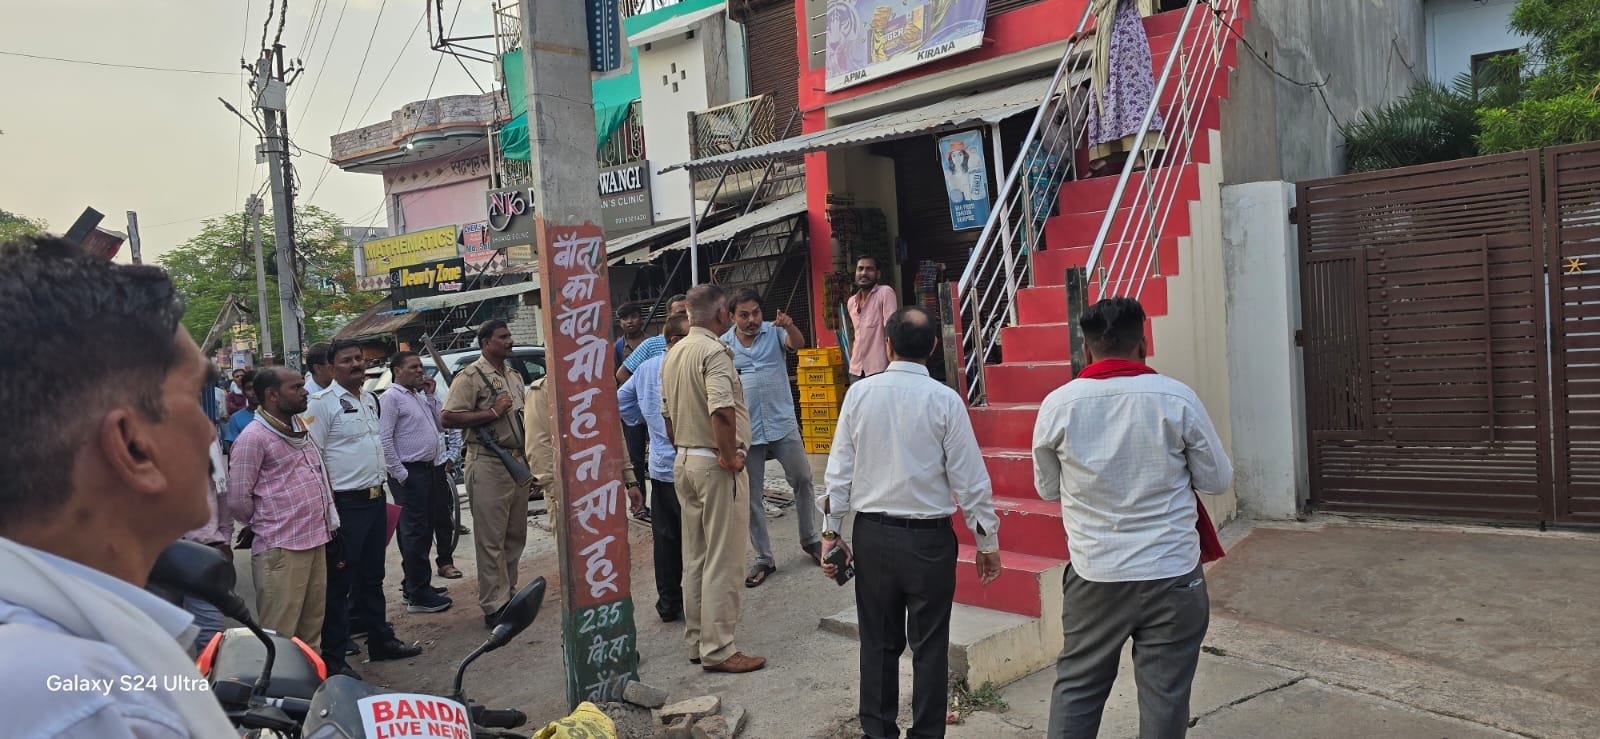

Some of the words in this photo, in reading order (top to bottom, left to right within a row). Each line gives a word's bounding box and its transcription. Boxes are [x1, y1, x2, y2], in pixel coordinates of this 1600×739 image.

[843, 69, 867, 84] APNA
[917, 41, 956, 61] KIRANA
[617, 194, 645, 206] CLINIC
[366, 231, 454, 261] MATHEMATICS
[402, 267, 436, 289] Beauty
[435, 263, 461, 283] Zone
[579, 601, 623, 634] 235
[372, 699, 468, 730] BANDA
[375, 721, 423, 739] LIVE
[427, 722, 470, 739] NEWS
